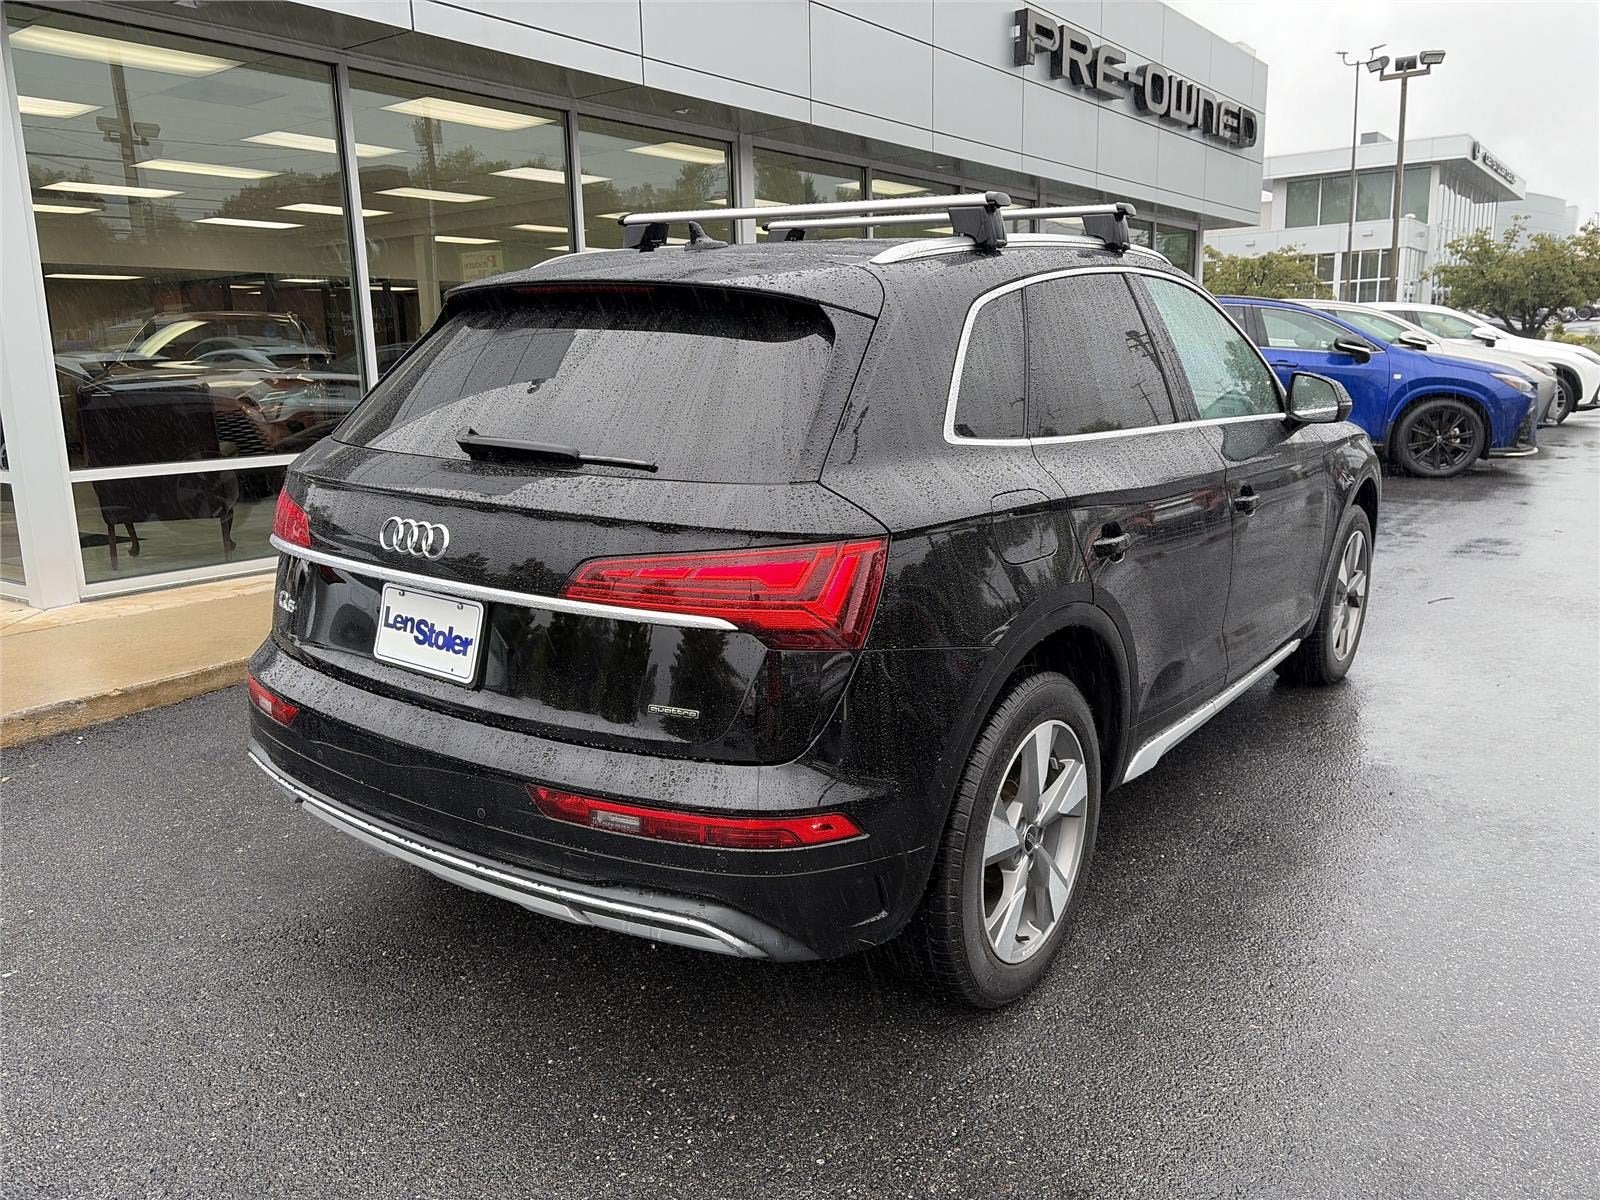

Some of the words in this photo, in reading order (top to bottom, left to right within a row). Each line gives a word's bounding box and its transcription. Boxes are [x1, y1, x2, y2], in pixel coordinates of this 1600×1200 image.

[1013, 8, 1258, 148] PRE-OWNED
[279, 590, 295, 613] Q5
[649, 705, 697, 718] quattro
